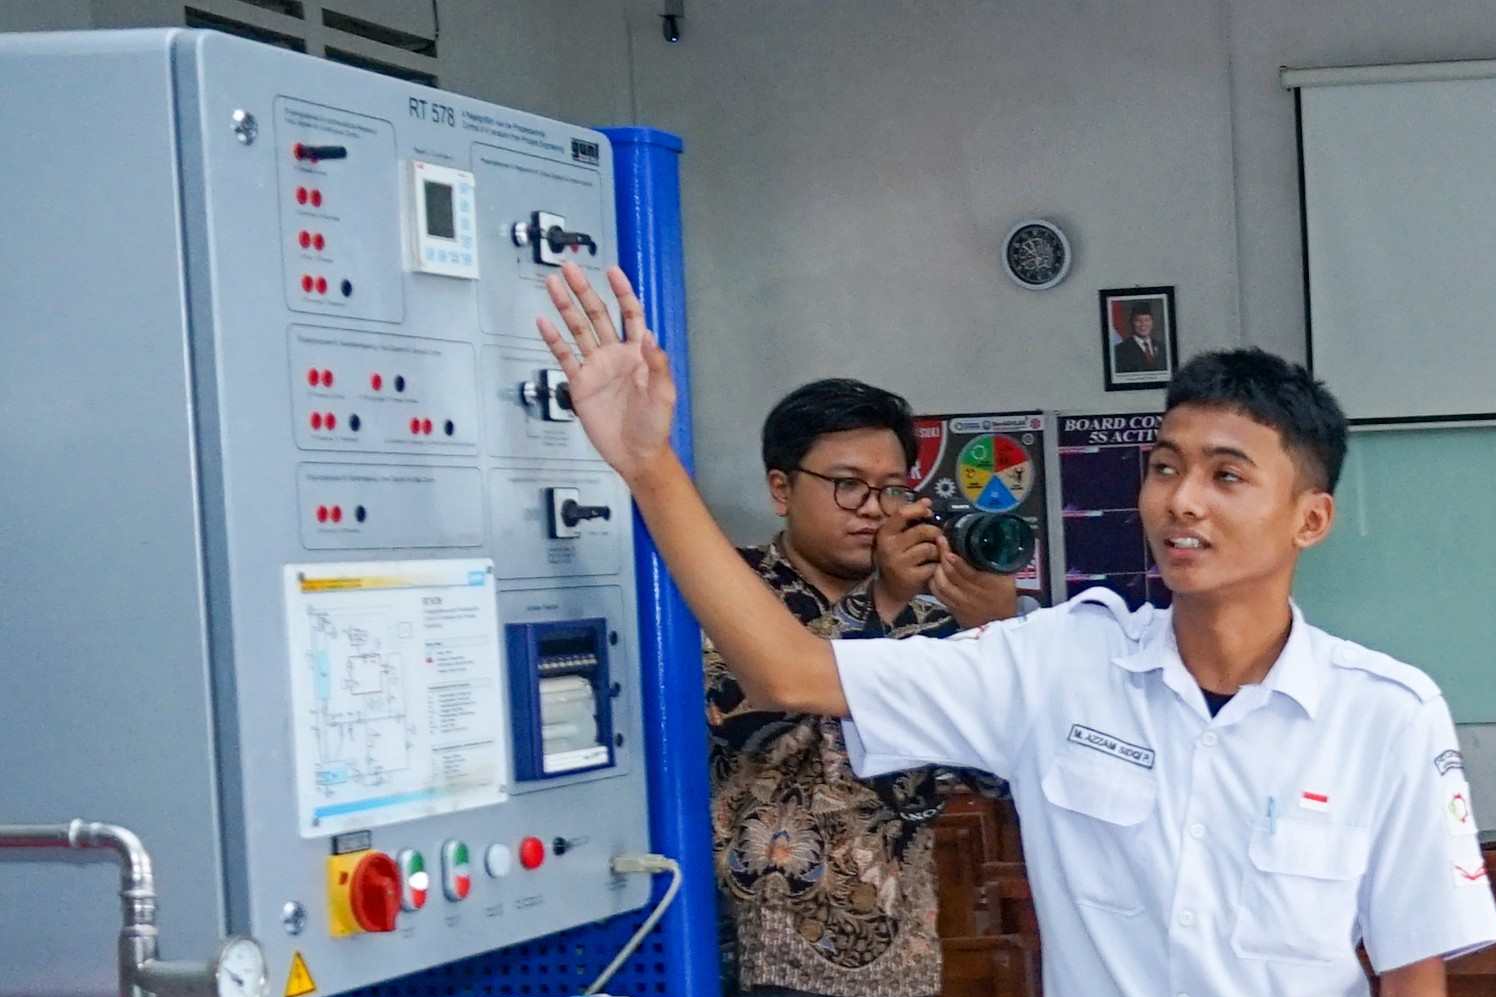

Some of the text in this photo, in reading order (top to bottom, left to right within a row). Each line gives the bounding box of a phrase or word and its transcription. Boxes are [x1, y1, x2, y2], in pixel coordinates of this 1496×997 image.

[409, 96, 428, 120] RT
[432, 103, 456, 128] 578
[1064, 418, 1126, 431] BOARD
